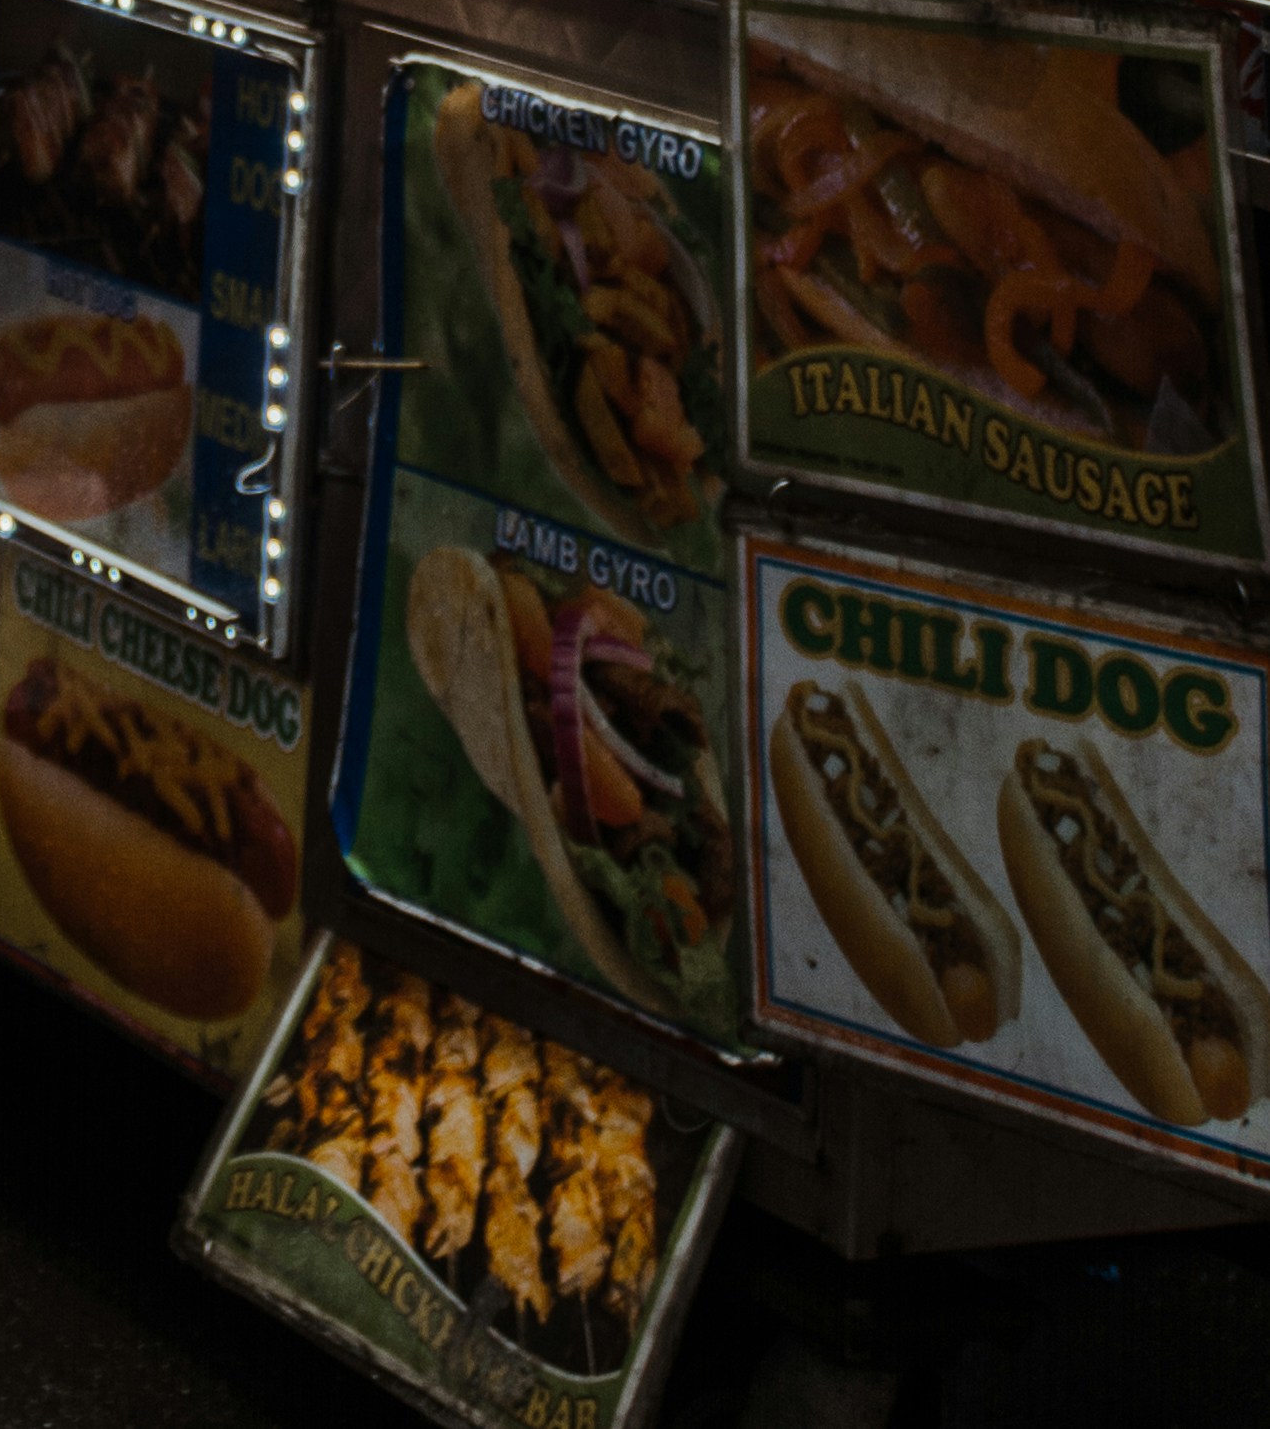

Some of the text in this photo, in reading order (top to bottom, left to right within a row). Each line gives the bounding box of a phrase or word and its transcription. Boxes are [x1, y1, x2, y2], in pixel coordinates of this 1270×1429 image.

[481, 84, 703, 181] CHICKEN GYRO
[788, 361, 1200, 531] ITALIAN SAUSAGE
[494, 506, 677, 612] LAMB GYRO
[16, 559, 302, 753] CHILI CHEESE DOG
[780, 577, 1239, 756] CHILI DOG
